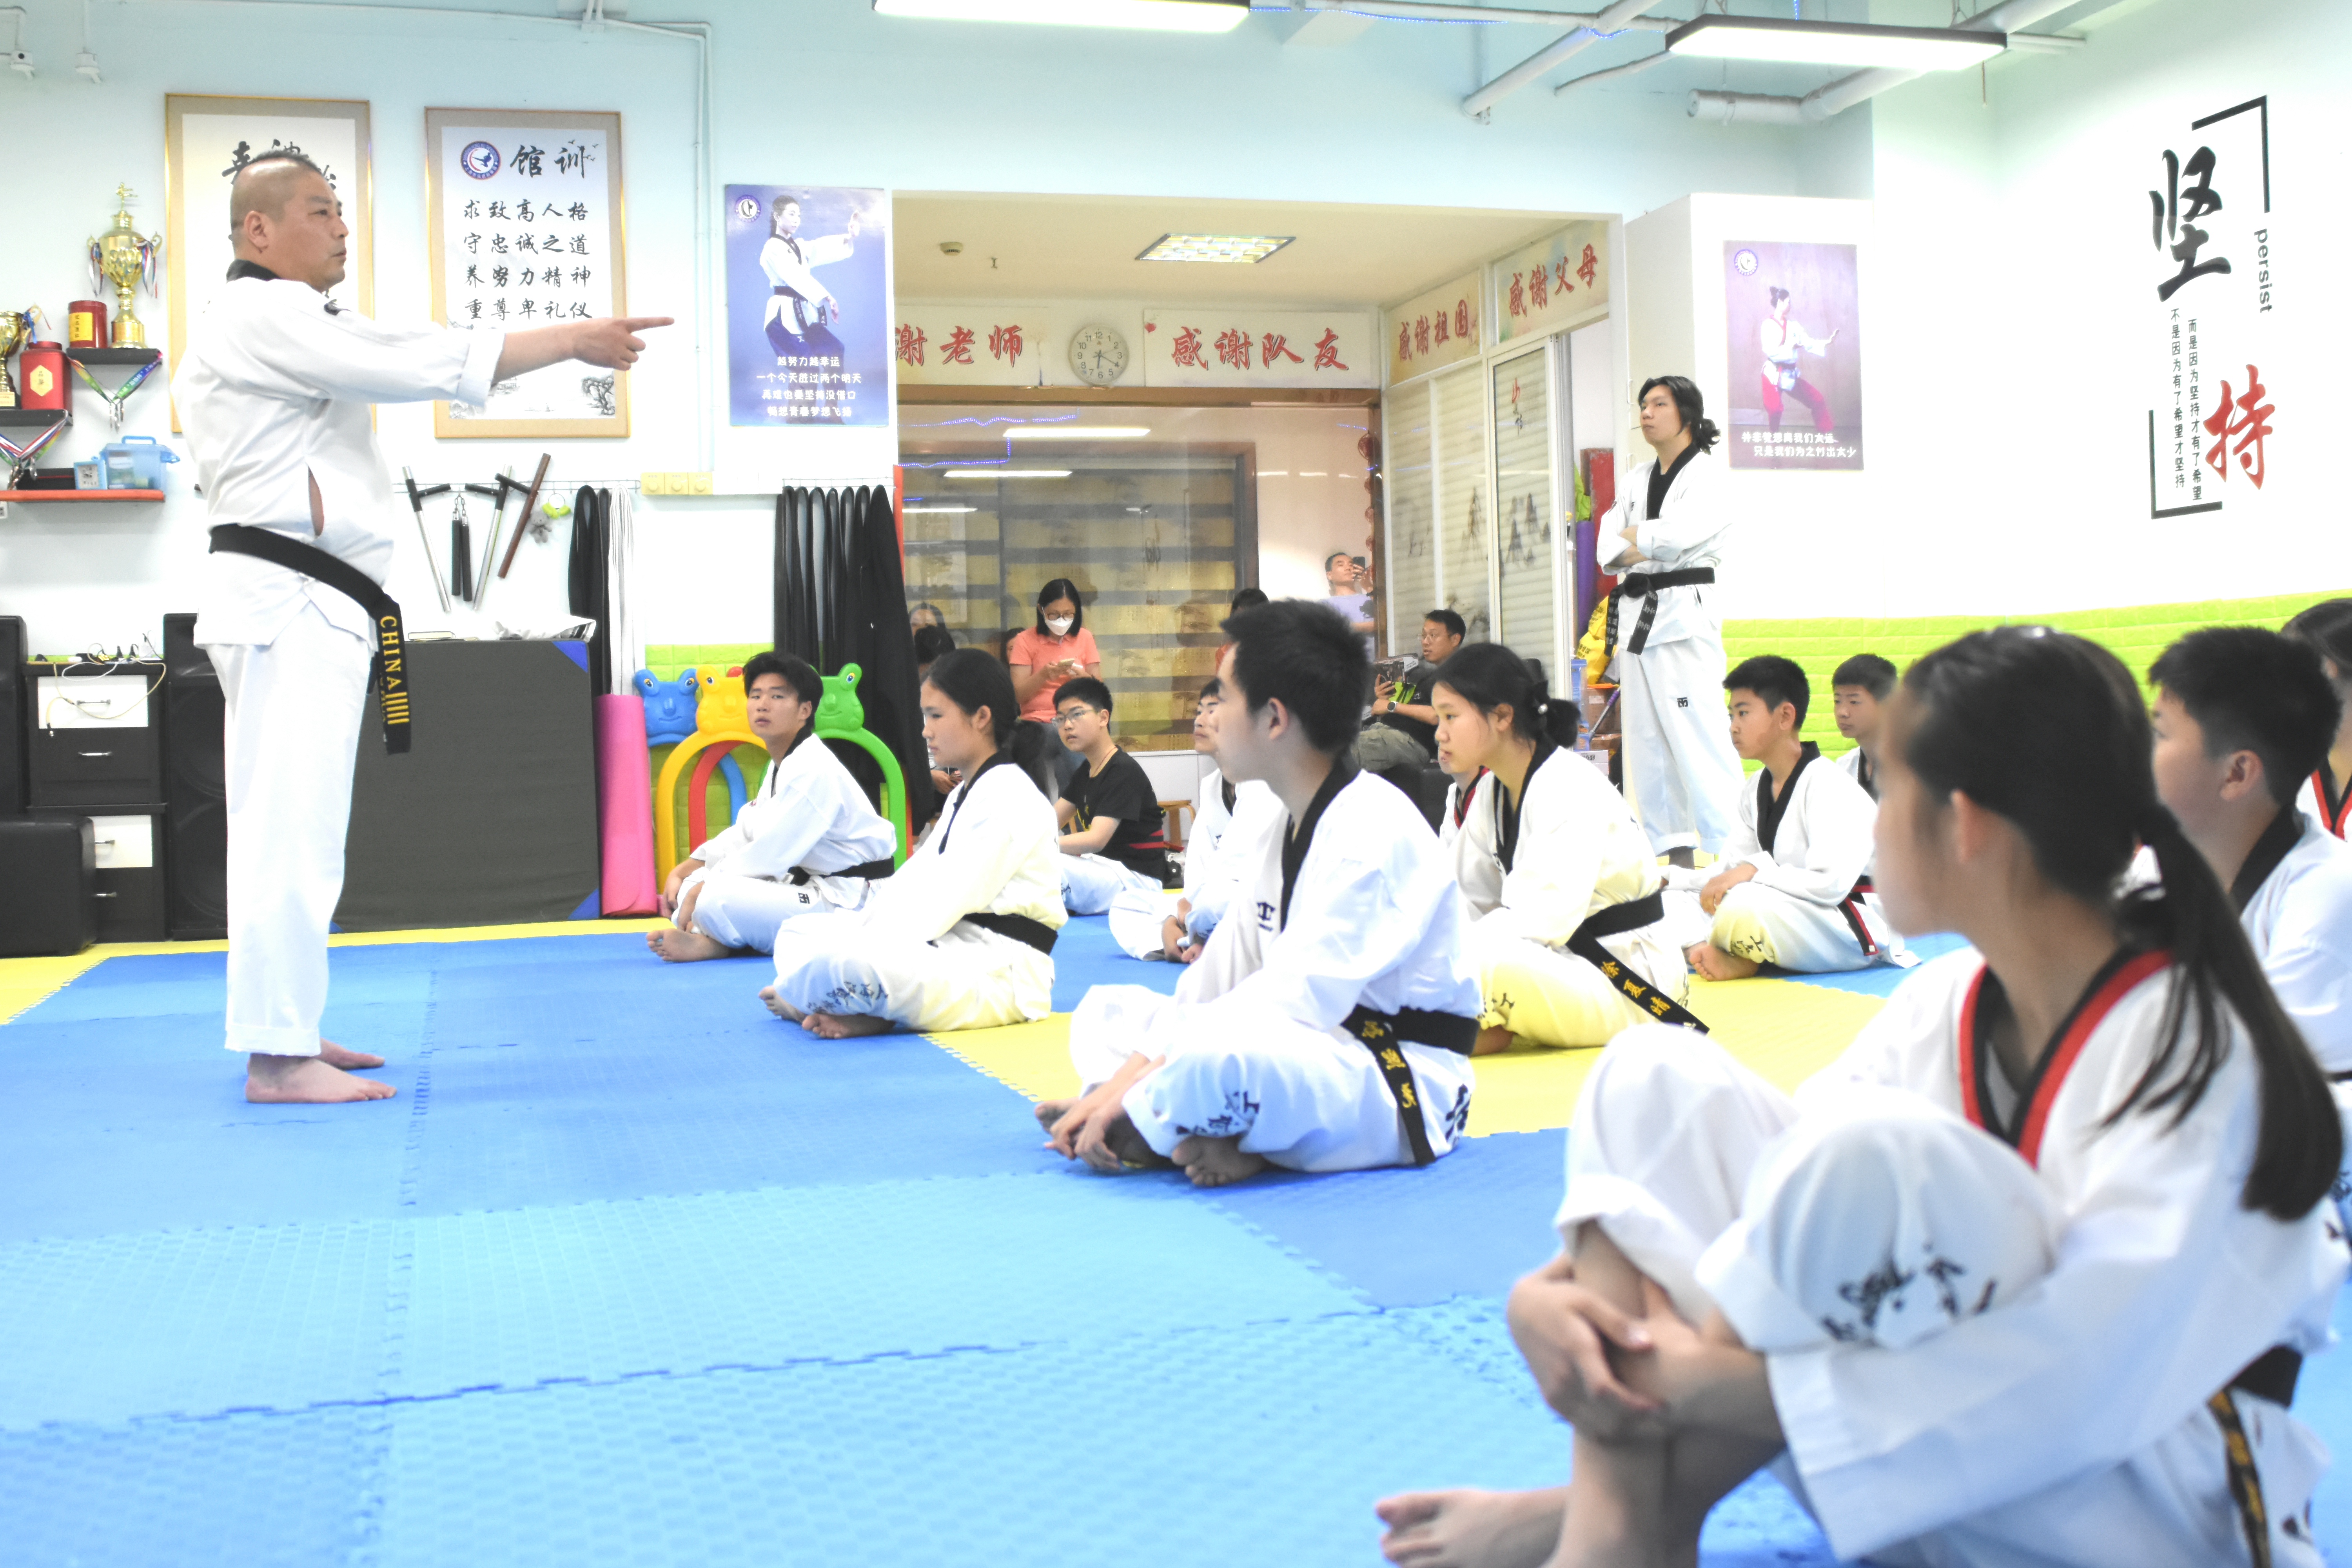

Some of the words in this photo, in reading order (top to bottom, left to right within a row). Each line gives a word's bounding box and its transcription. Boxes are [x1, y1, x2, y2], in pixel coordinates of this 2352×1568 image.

[510, 145, 586, 179] 馆训
[464, 198, 588, 223] 求致高人格
[2149, 146, 2231, 302] 坚
[463, 232, 590, 255] 守忠诚之道
[464, 264, 591, 289] 养努力精神
[1509, 243, 1598, 318] 感谢父母
[2254, 229, 2272, 313] persist
[465, 297, 593, 321] 重尊卑礼仪
[1399, 299, 1468, 361] 感谢祖国
[777, 356, 840, 367] 越努力越幸运
[1171, 326, 1349, 371] 感谢队友
[756, 373, 862, 383] 一个今天胜过两个明天
[761, 389, 856, 400] 再难也要坚持没借口
[2171, 308, 2185, 488] 不是因为有了希望才坚持
[767, 406, 852, 417] 畅想青春梦想飞扬
[2188, 318, 2202, 501] 而是因为坚持才有了希望
[1741, 432, 1834, 443] 并非梦想离我们太远
[2203, 364, 2275, 490] 持
[1754, 445, 1857, 457] 只是我们为之付出太少
[380, 615, 402, 691] CHINA
